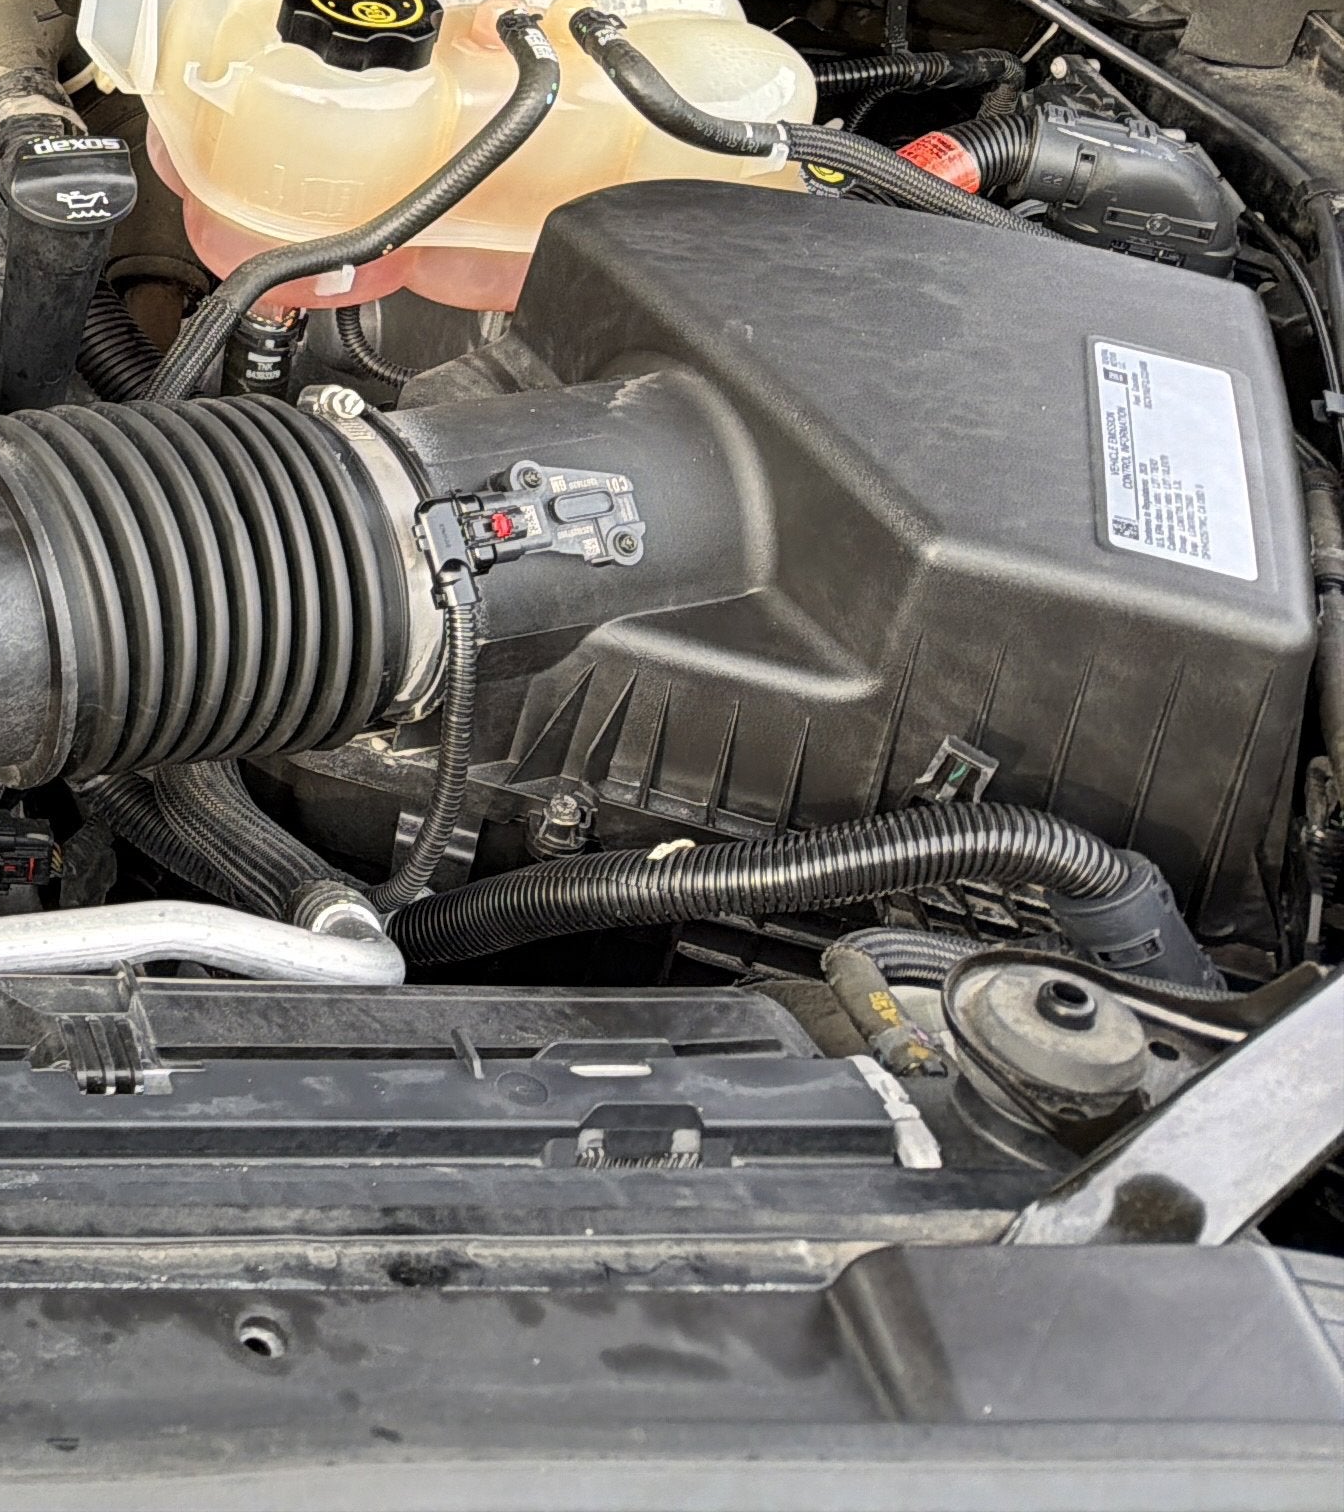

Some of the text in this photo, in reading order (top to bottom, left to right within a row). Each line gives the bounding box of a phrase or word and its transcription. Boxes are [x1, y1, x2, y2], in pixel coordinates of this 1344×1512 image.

[33, 138, 120, 154] dexos
[1106, 411, 1120, 476] VEHICLE EMISSION
[1117, 406, 1132, 489] CONTROL INFORMATION
